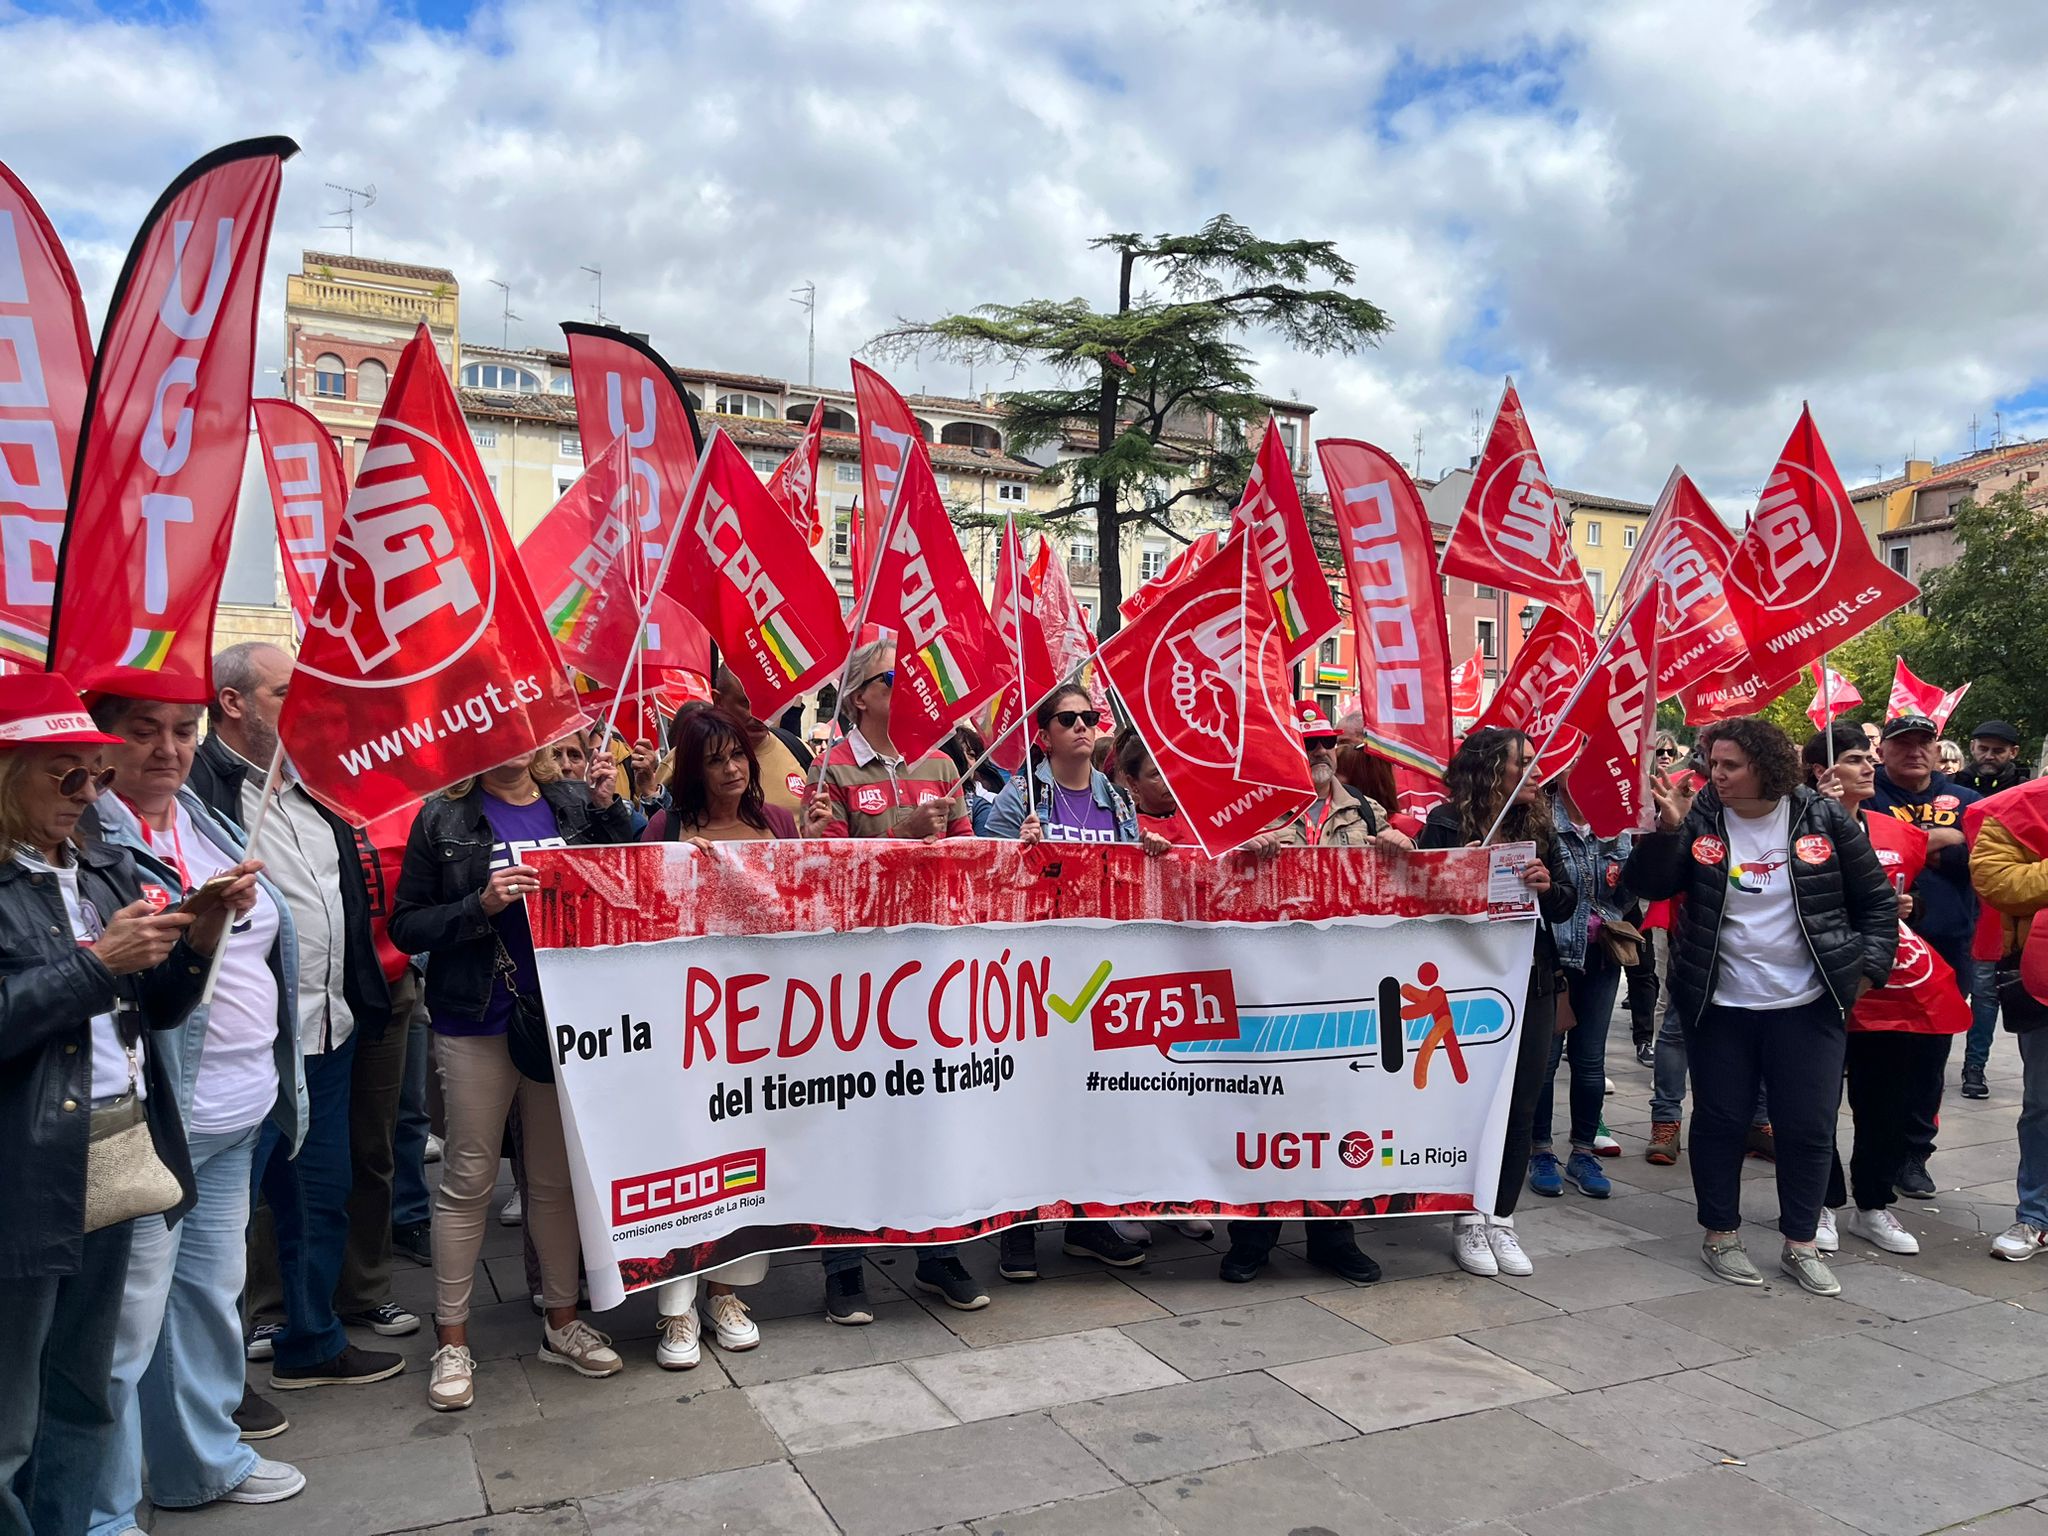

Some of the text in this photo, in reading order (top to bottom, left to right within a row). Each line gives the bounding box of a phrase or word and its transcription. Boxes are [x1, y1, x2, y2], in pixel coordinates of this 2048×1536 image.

[141, 218, 234, 614] UGT
[345, 443, 481, 636] UGT
[1496, 459, 1554, 560] UGT
[1754, 471, 1827, 582] UGT
[694, 482, 785, 625] CCOO
[1652, 526, 1723, 612] UGT
[1765, 585, 1882, 654] www.ugt.es
[744, 628, 782, 690] La Rioja
[1658, 620, 1739, 683] www.UG
[900, 653, 940, 721] La Rioja
[1503, 642, 1570, 728] UGT
[45, 717, 76, 731] UGT
[338, 672, 544, 777] www.ugt.es
[787, 776, 803, 789] UGT
[858, 789, 882, 802] UGT
[1606, 757, 1621, 777] La
[1702, 837, 1722, 851] UGT
[1800, 837, 1823, 849] UGT
[556, 948, 1051, 1070] Por la REDUCCIÓN
[1103, 983, 1225, 1038] 37,5 h
[709, 1048, 1015, 1123] del tiempo de trabajo
[1086, 1071, 1285, 1097] #reducciónjornadaYA
[1236, 1132, 1331, 1170] UGT
[1400, 1148, 1467, 1168] La Rioja
[612, 1195, 766, 1242] comisiones obreras de La Rioja
[620, 1166, 719, 1216] CCOO
